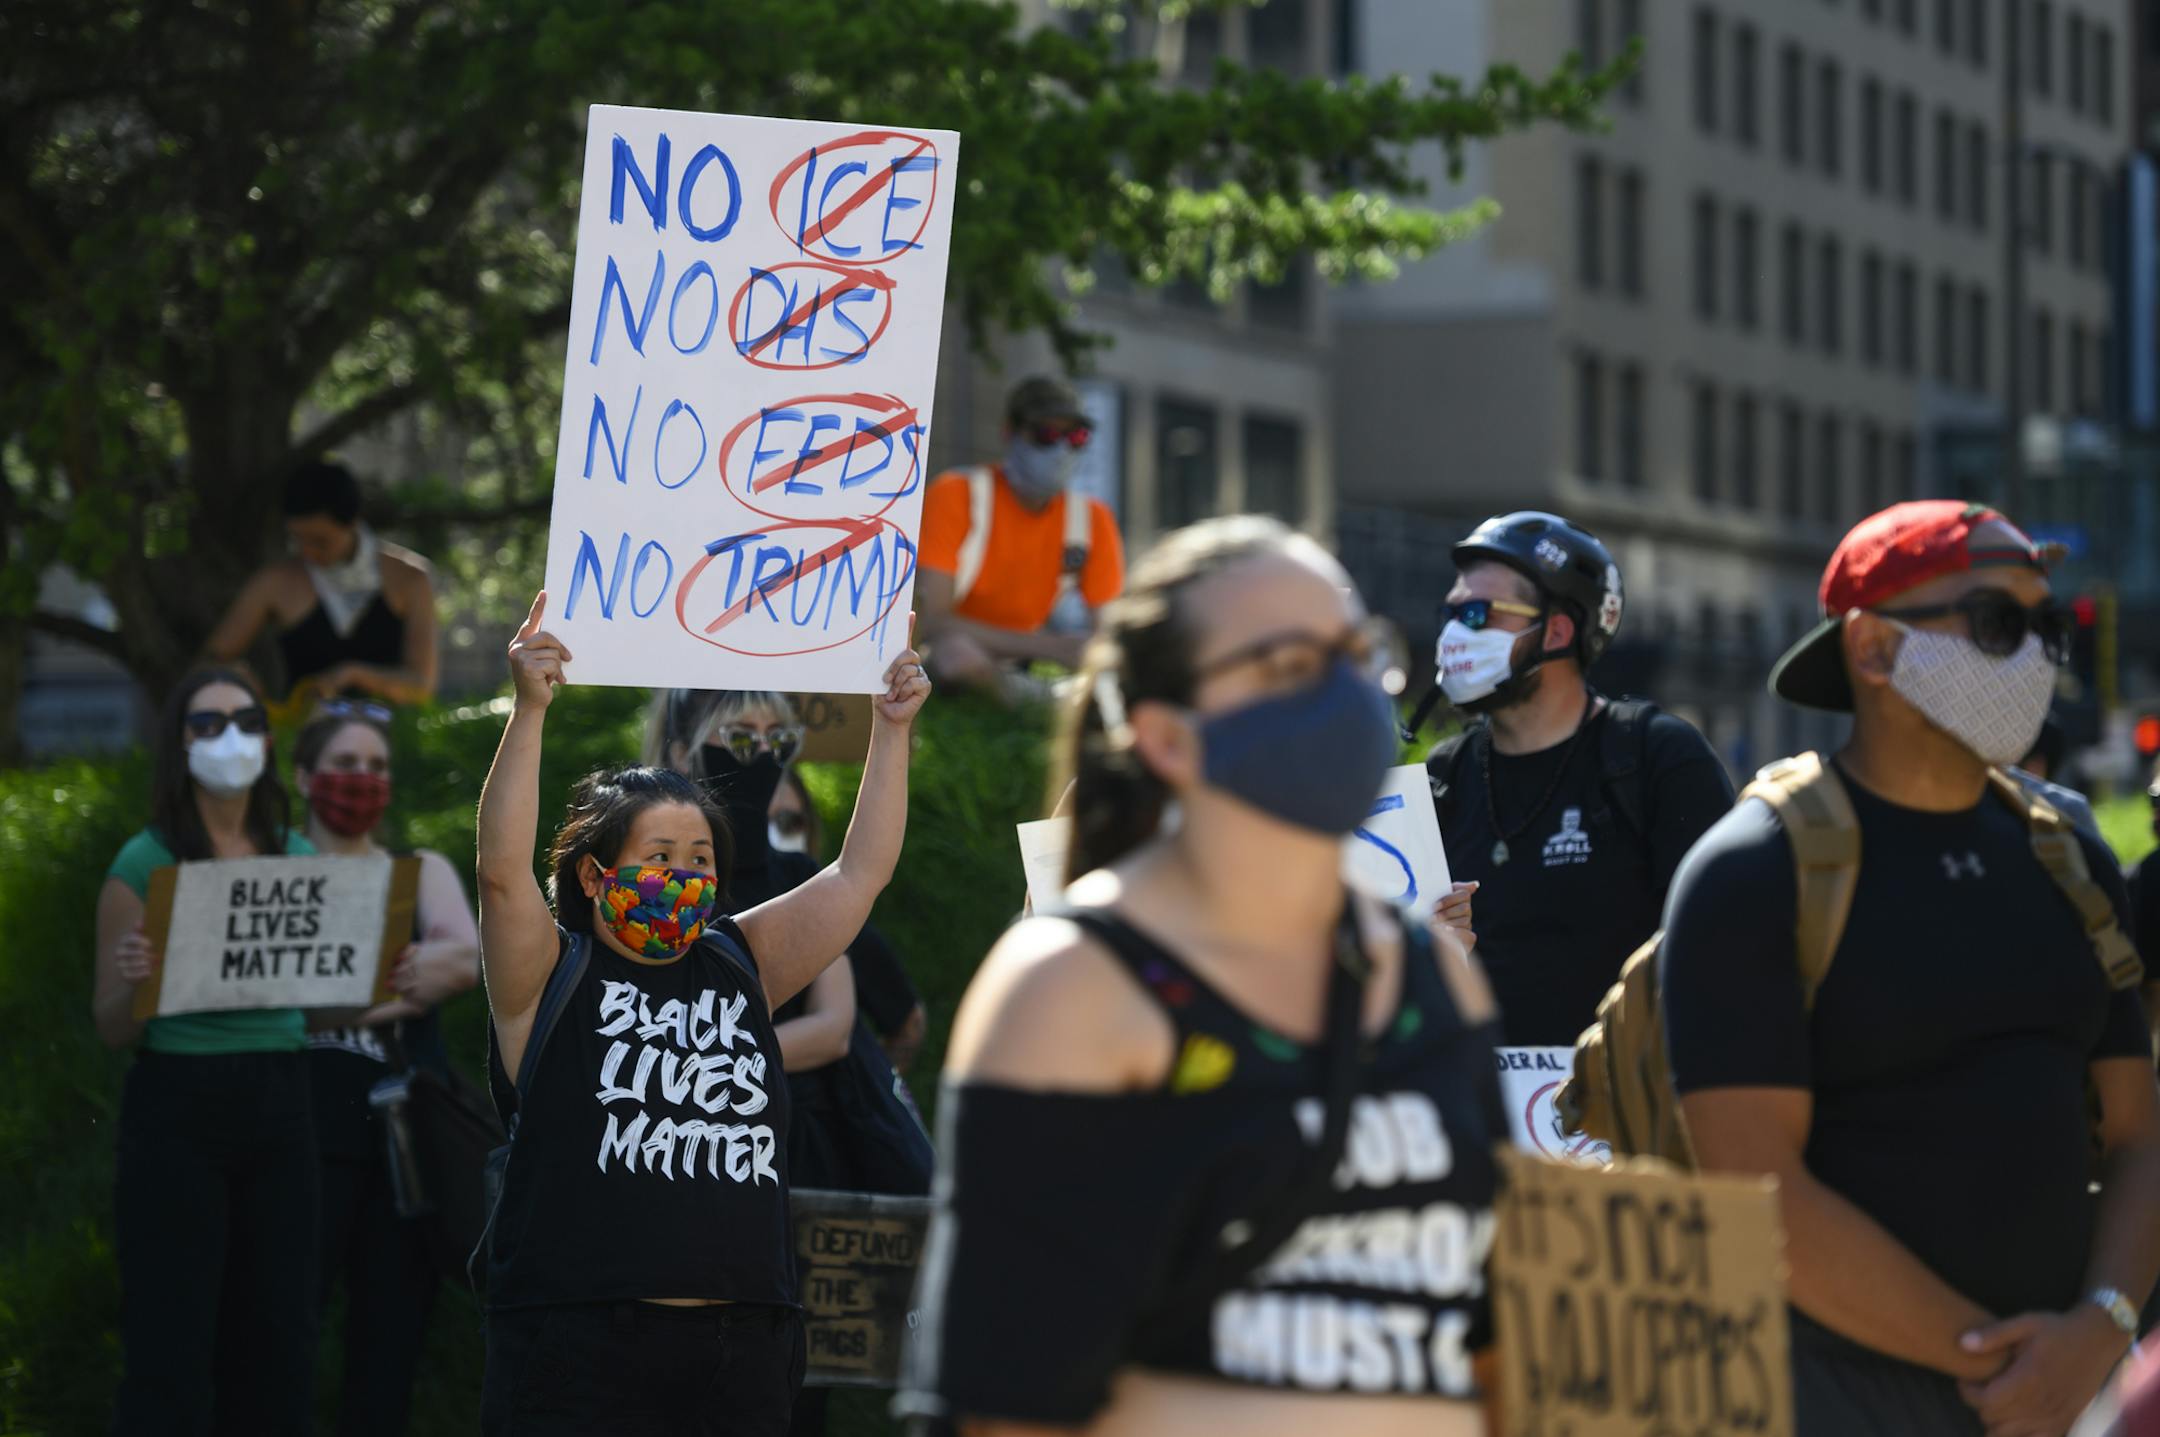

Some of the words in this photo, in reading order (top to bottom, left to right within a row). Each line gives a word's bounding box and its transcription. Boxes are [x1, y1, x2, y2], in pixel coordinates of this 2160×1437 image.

[609, 132, 742, 242] NO
[797, 146, 942, 256] ICE
[590, 249, 719, 366] NO
[735, 266, 876, 367] DHS
[583, 384, 707, 489] NO
[746, 406, 926, 499] FEDS
[564, 530, 673, 621] NO
[704, 531, 918, 661] TRUMP
[226, 909, 320, 942] LIVES
[228, 875, 328, 908] BLACK
[220, 943, 356, 981] MATTER
[595, 980, 758, 1051] BLACK
[595, 1040, 769, 1116] LIVES
[597, 1109, 779, 1187] MATTER
[811, 1225, 914, 1261] DEFUND
[811, 1277, 859, 1306] THE
[810, 1327, 867, 1357] PIGS
